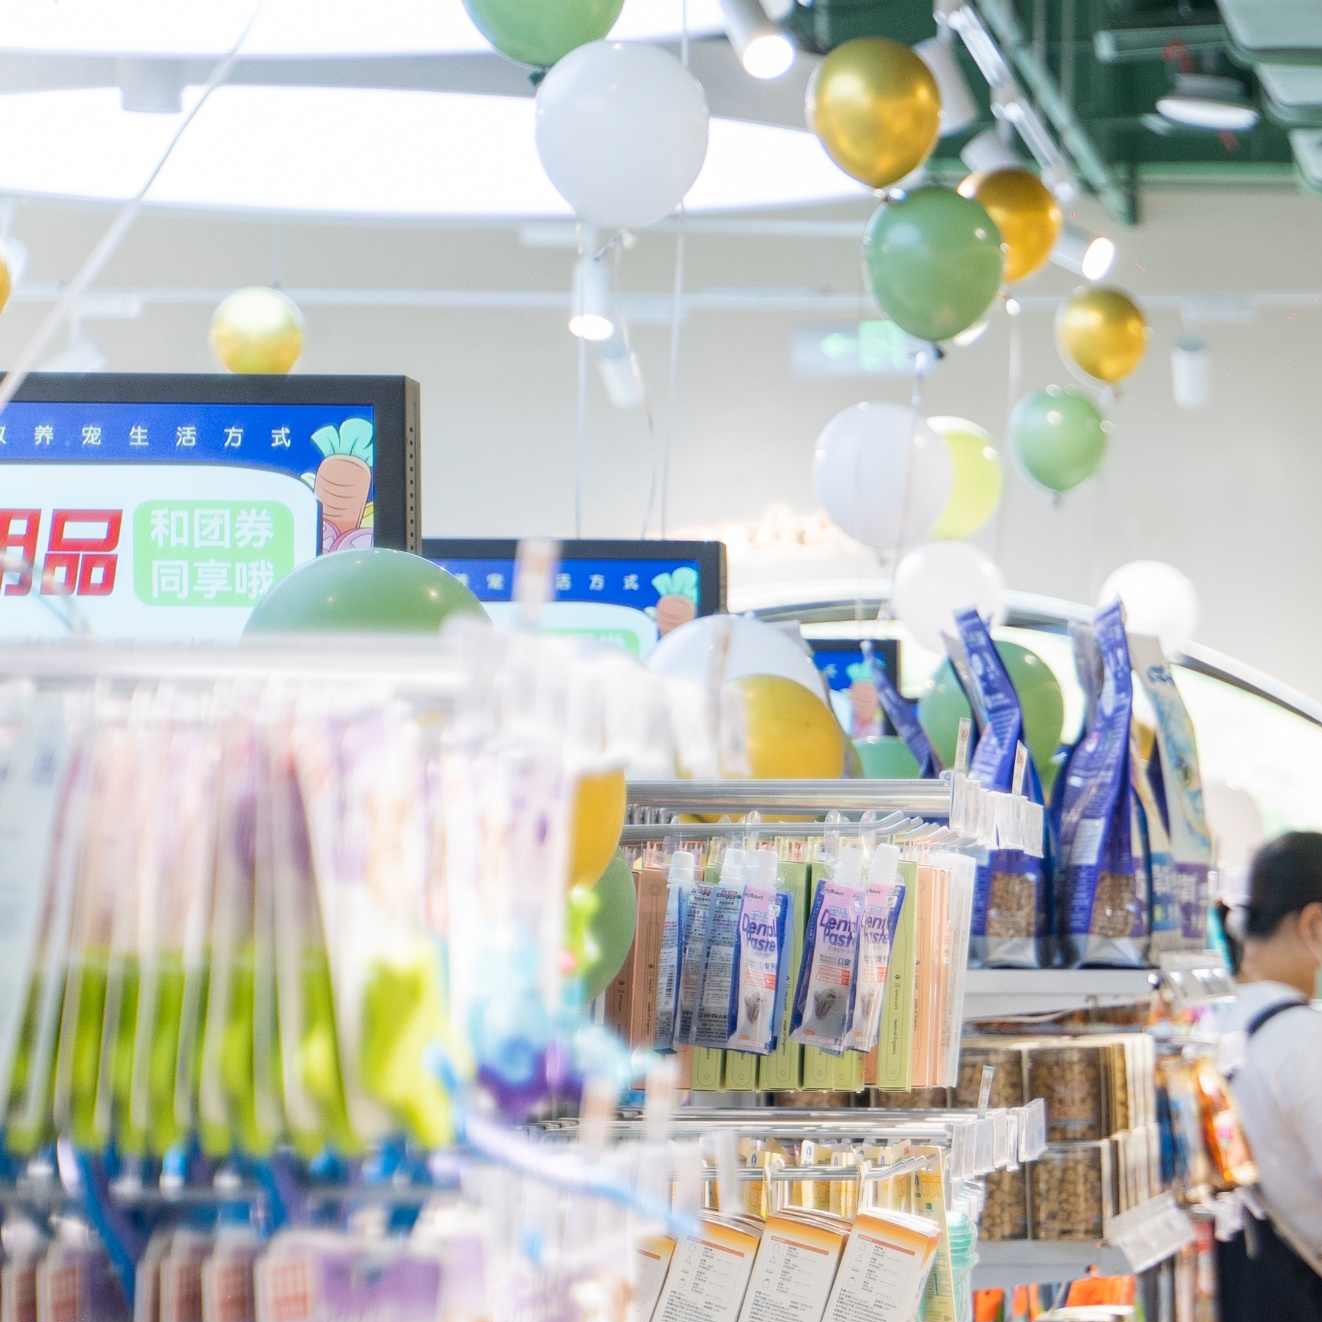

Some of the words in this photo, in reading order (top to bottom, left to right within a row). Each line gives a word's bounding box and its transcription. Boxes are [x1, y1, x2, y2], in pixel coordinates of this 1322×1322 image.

[0, 425, 291, 449] 养宠生活方式
[150, 507, 275, 549] 和团券
[151, 558, 275, 600] 同享哦
